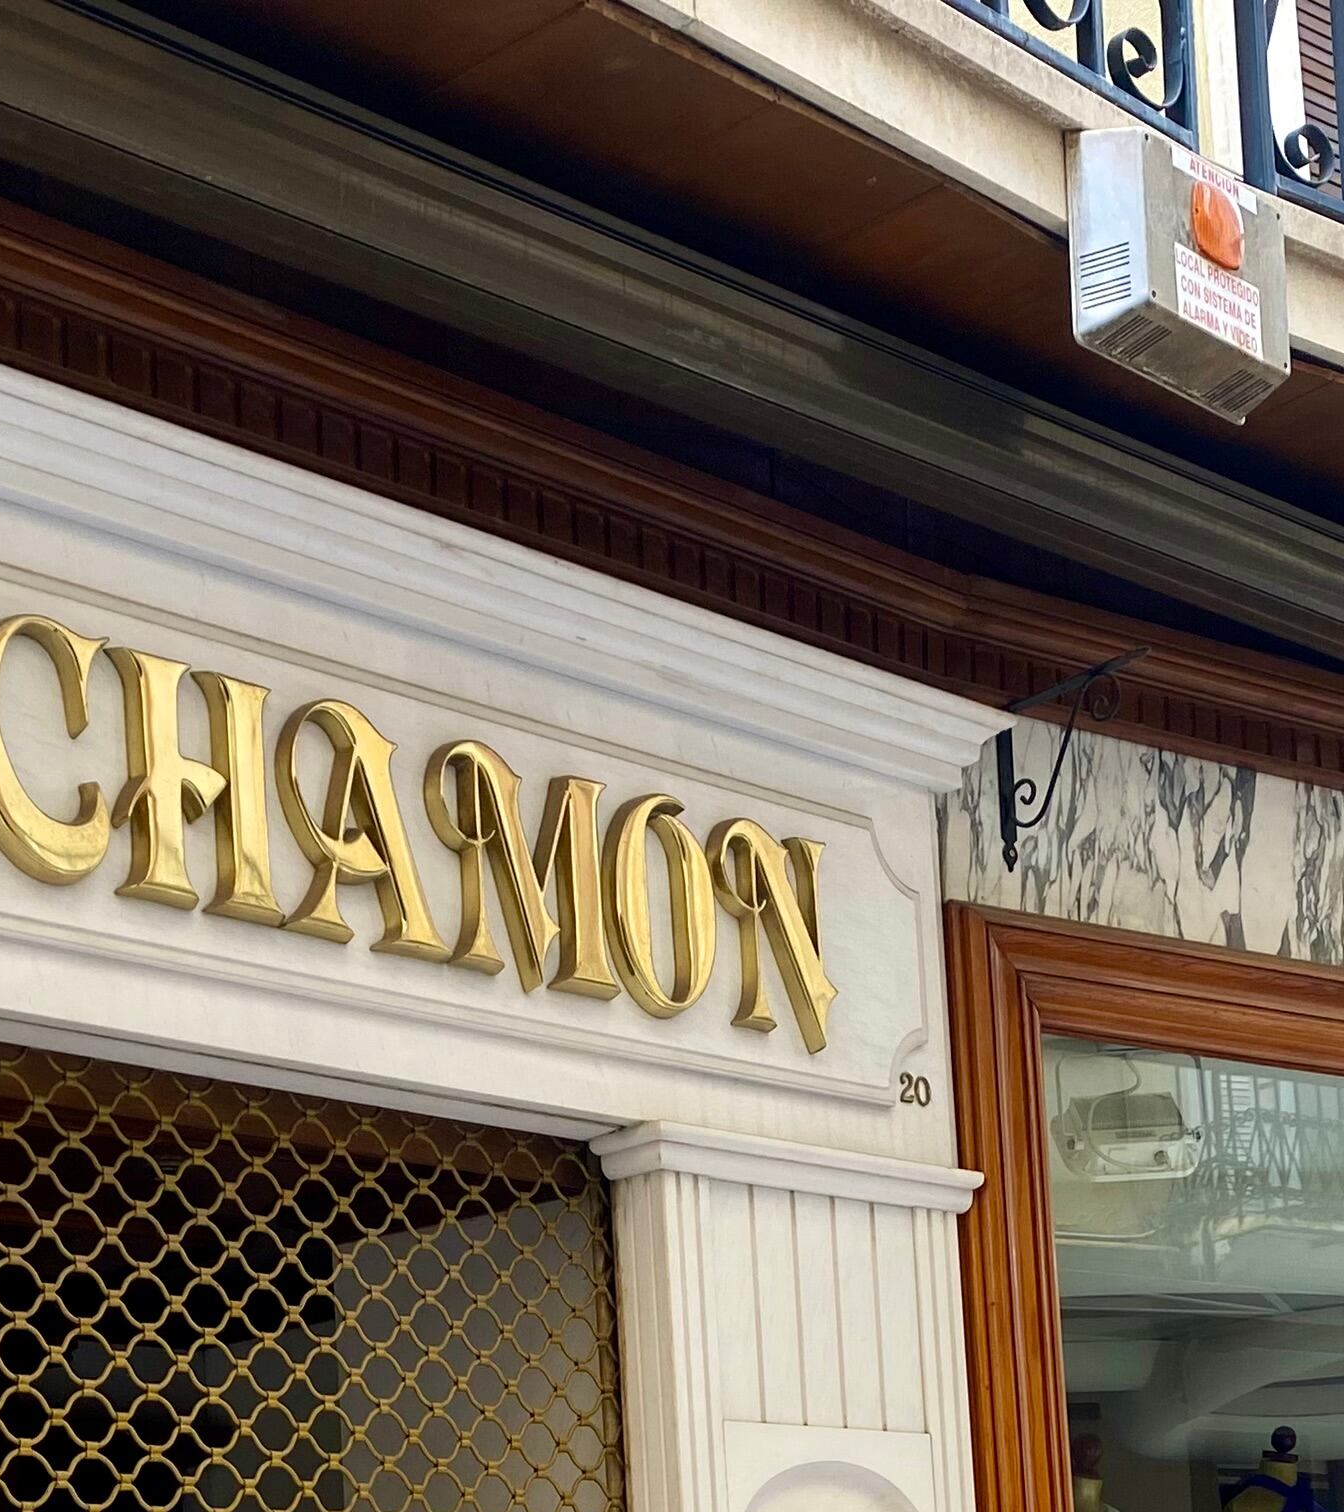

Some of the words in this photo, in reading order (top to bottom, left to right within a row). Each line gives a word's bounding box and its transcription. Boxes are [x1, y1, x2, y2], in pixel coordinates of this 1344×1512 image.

[1175, 246, 1206, 278] LOCAL
[1207, 264, 1260, 307] PROTEGIDO
[1180, 274, 1202, 299] CON
[1203, 286, 1243, 321] SISTEMA
[1244, 308, 1257, 330] DE
[1182, 300, 1221, 335] ALARMA
[1222, 320, 1229, 336] Y
[899, 1071, 932, 1108] 20
